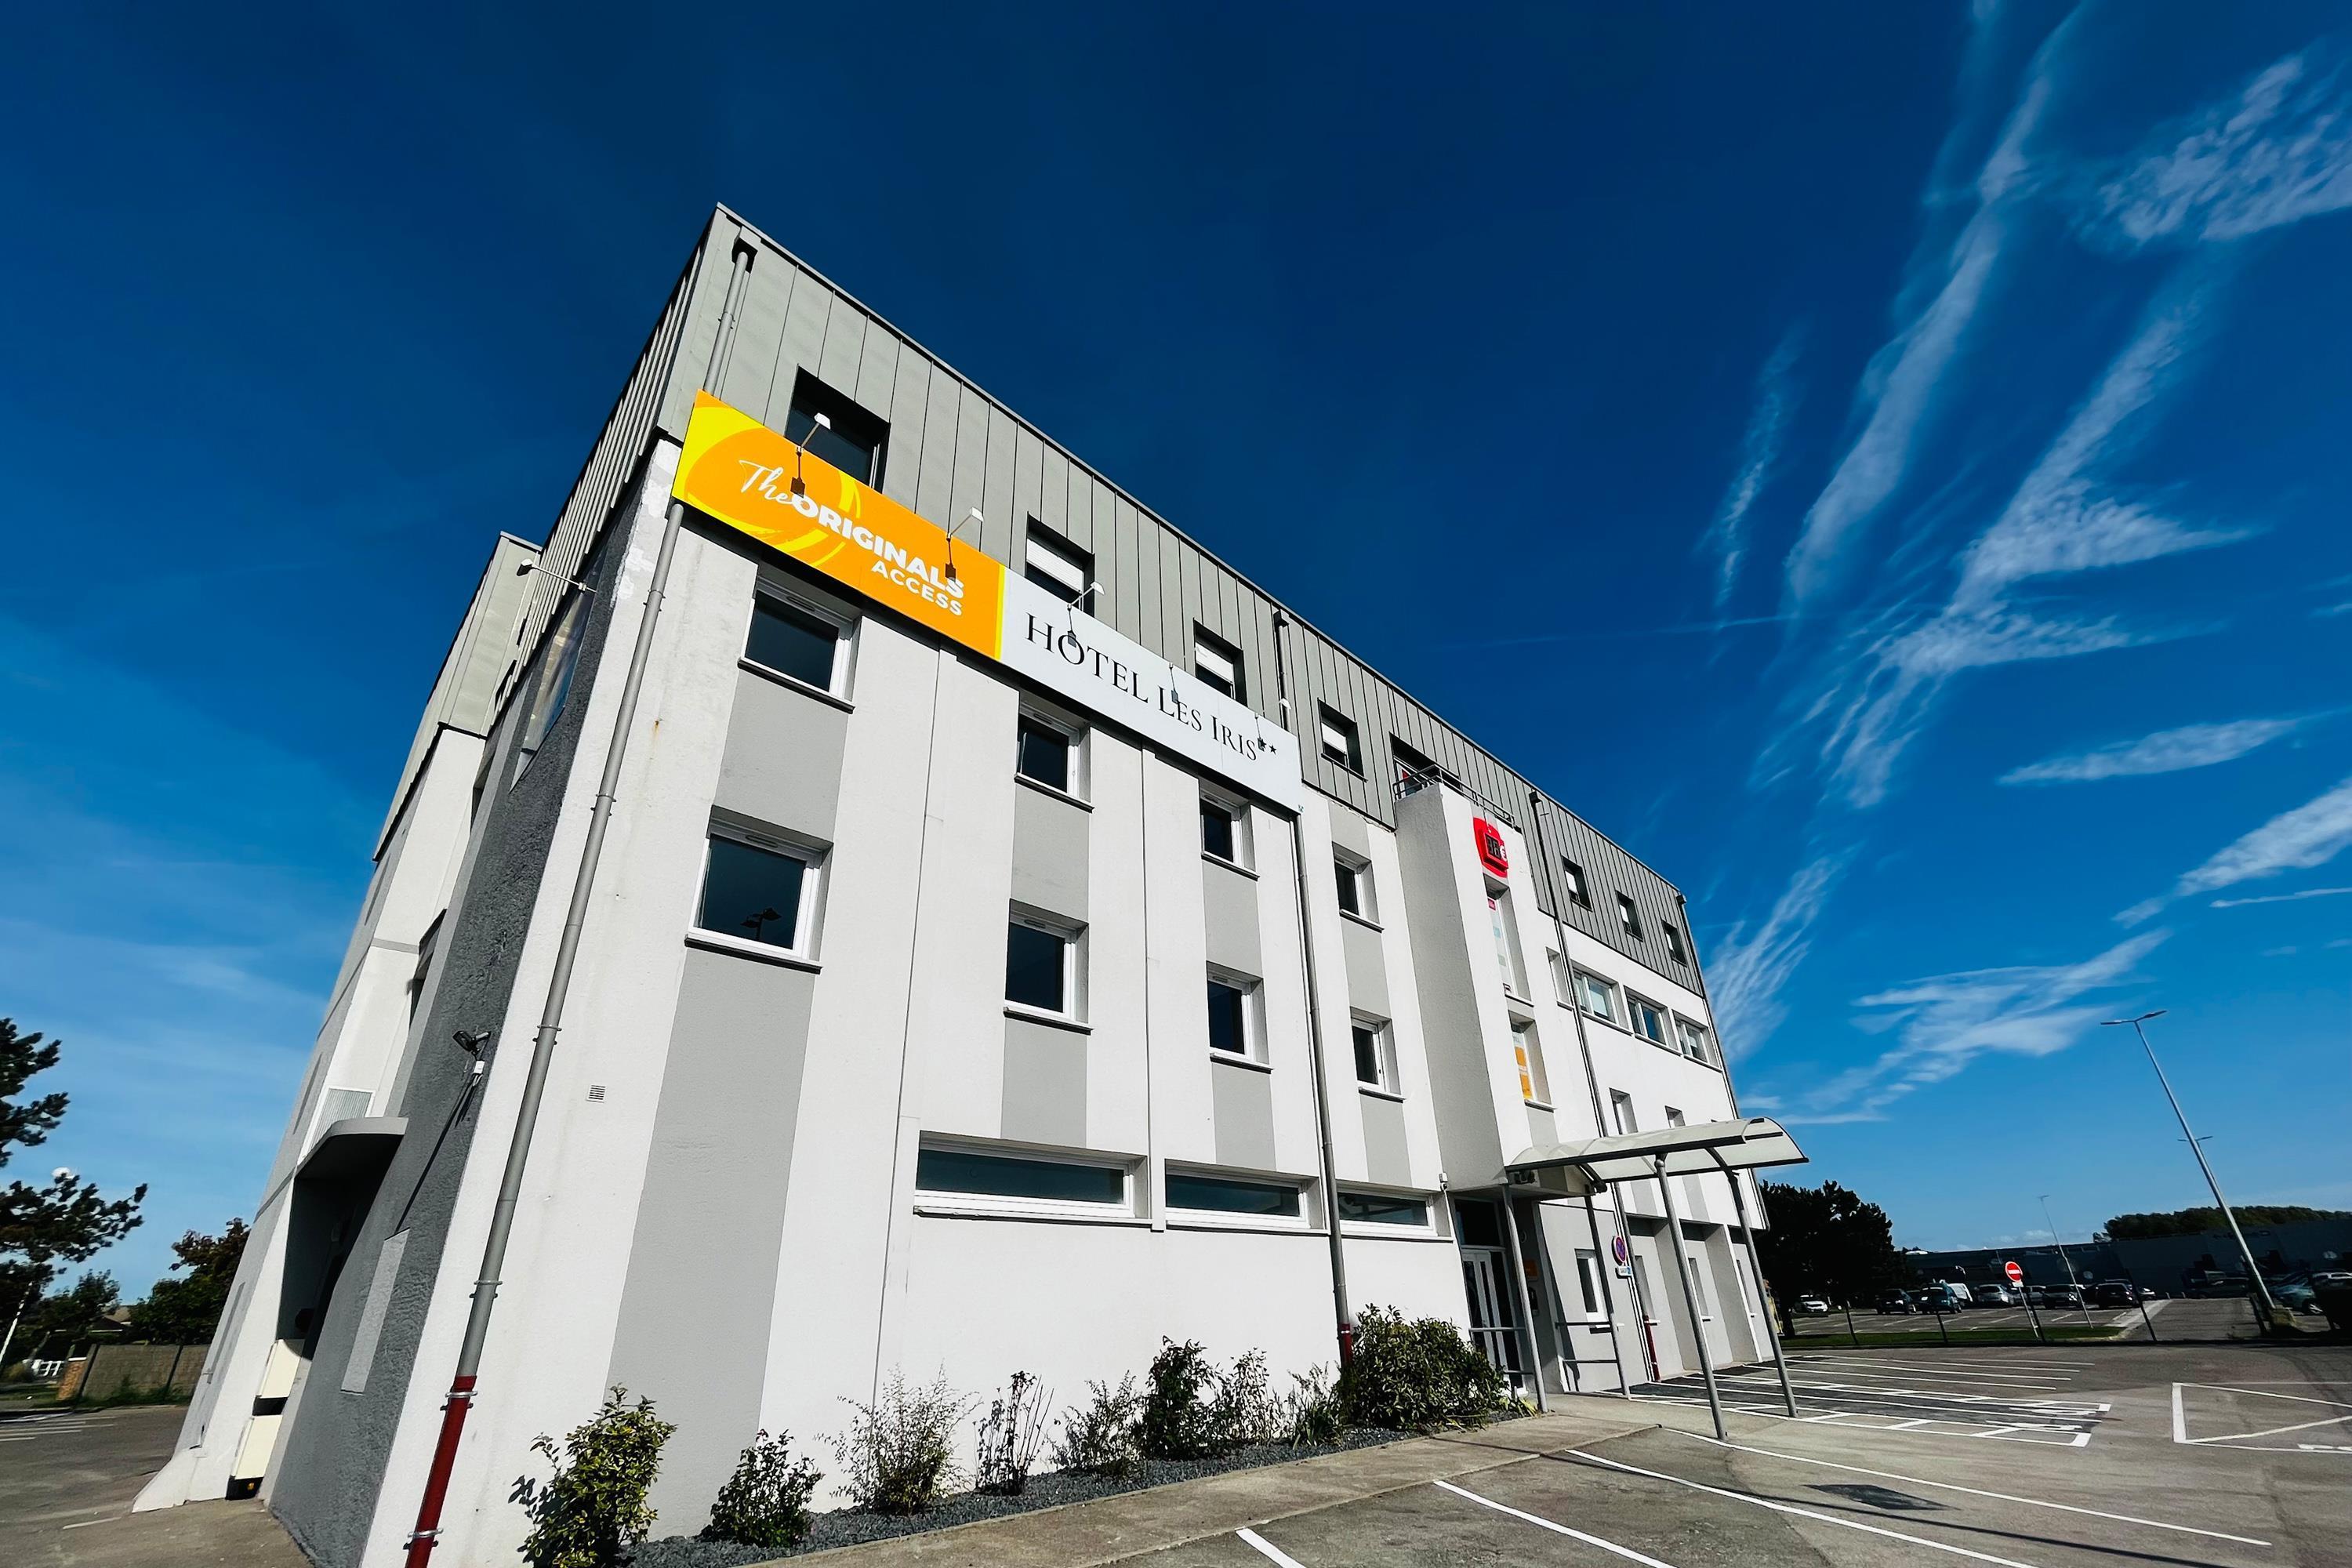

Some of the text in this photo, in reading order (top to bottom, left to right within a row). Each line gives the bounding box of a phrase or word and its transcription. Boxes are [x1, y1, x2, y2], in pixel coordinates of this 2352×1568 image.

[739, 459, 964, 600] The ORIGINALS
[871, 561, 963, 616] ACCESS
[1157, 686, 1203, 732] LES
[1210, 715, 1256, 761] IRIS
